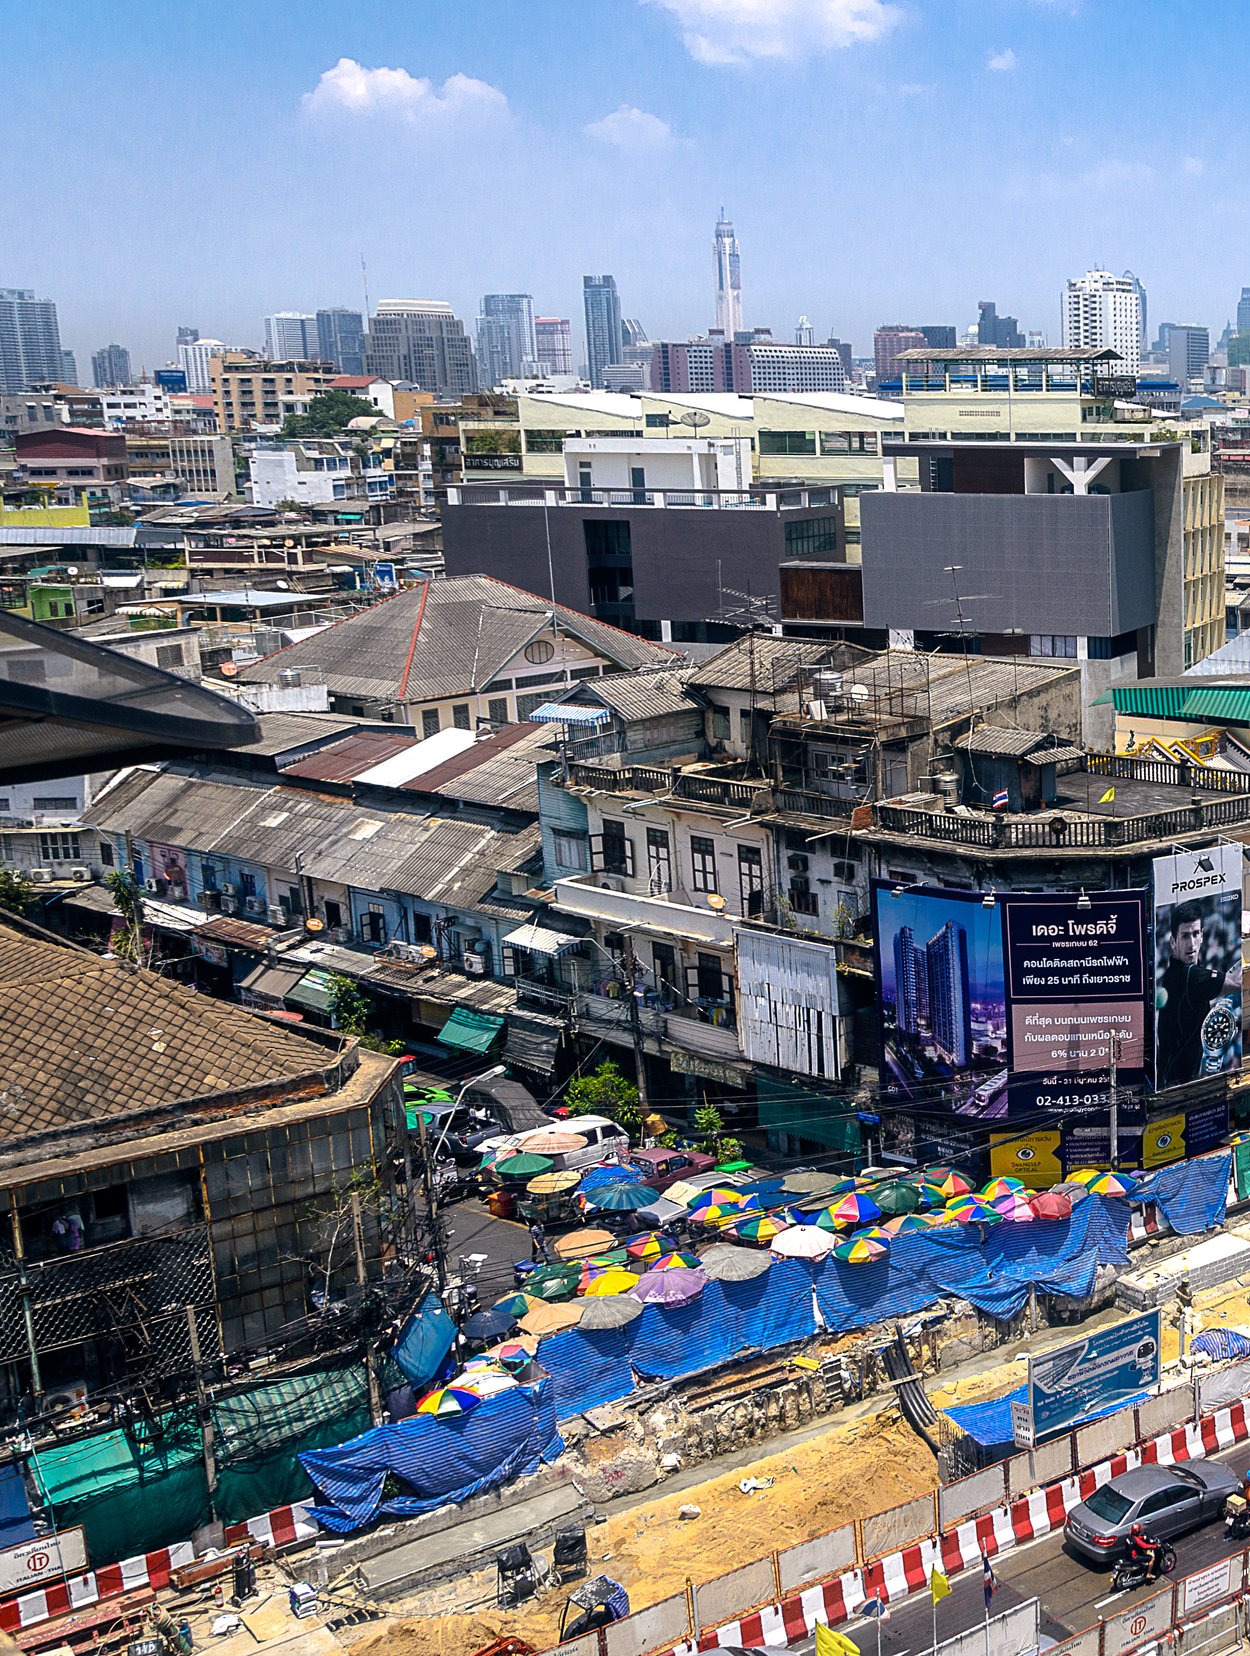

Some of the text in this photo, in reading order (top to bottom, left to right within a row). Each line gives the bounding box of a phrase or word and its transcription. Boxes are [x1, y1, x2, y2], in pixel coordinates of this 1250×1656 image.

[1171, 873, 1226, 894] PROSPEX
[1032, 914, 1117, 936] เดอะ โพรดิจี้
[1088, 939, 1098, 947] 62
[1023, 955, 1129, 968] คอนโดติดสถานีรถไฟฟ้า
[1022, 973, 1131, 985] เพียง 25 นาที ถึงเยาวราช
[1025, 1012, 1132, 1028] ดีที่สุด บนถนนเพชรเกษม
[1051, 1049, 1067, 1058] 6%
[1069, 1049, 1088, 1057] นาน
[1090, 1048, 1096, 1057] 2
[16, 1571, 43, 1583] ITALIAN
